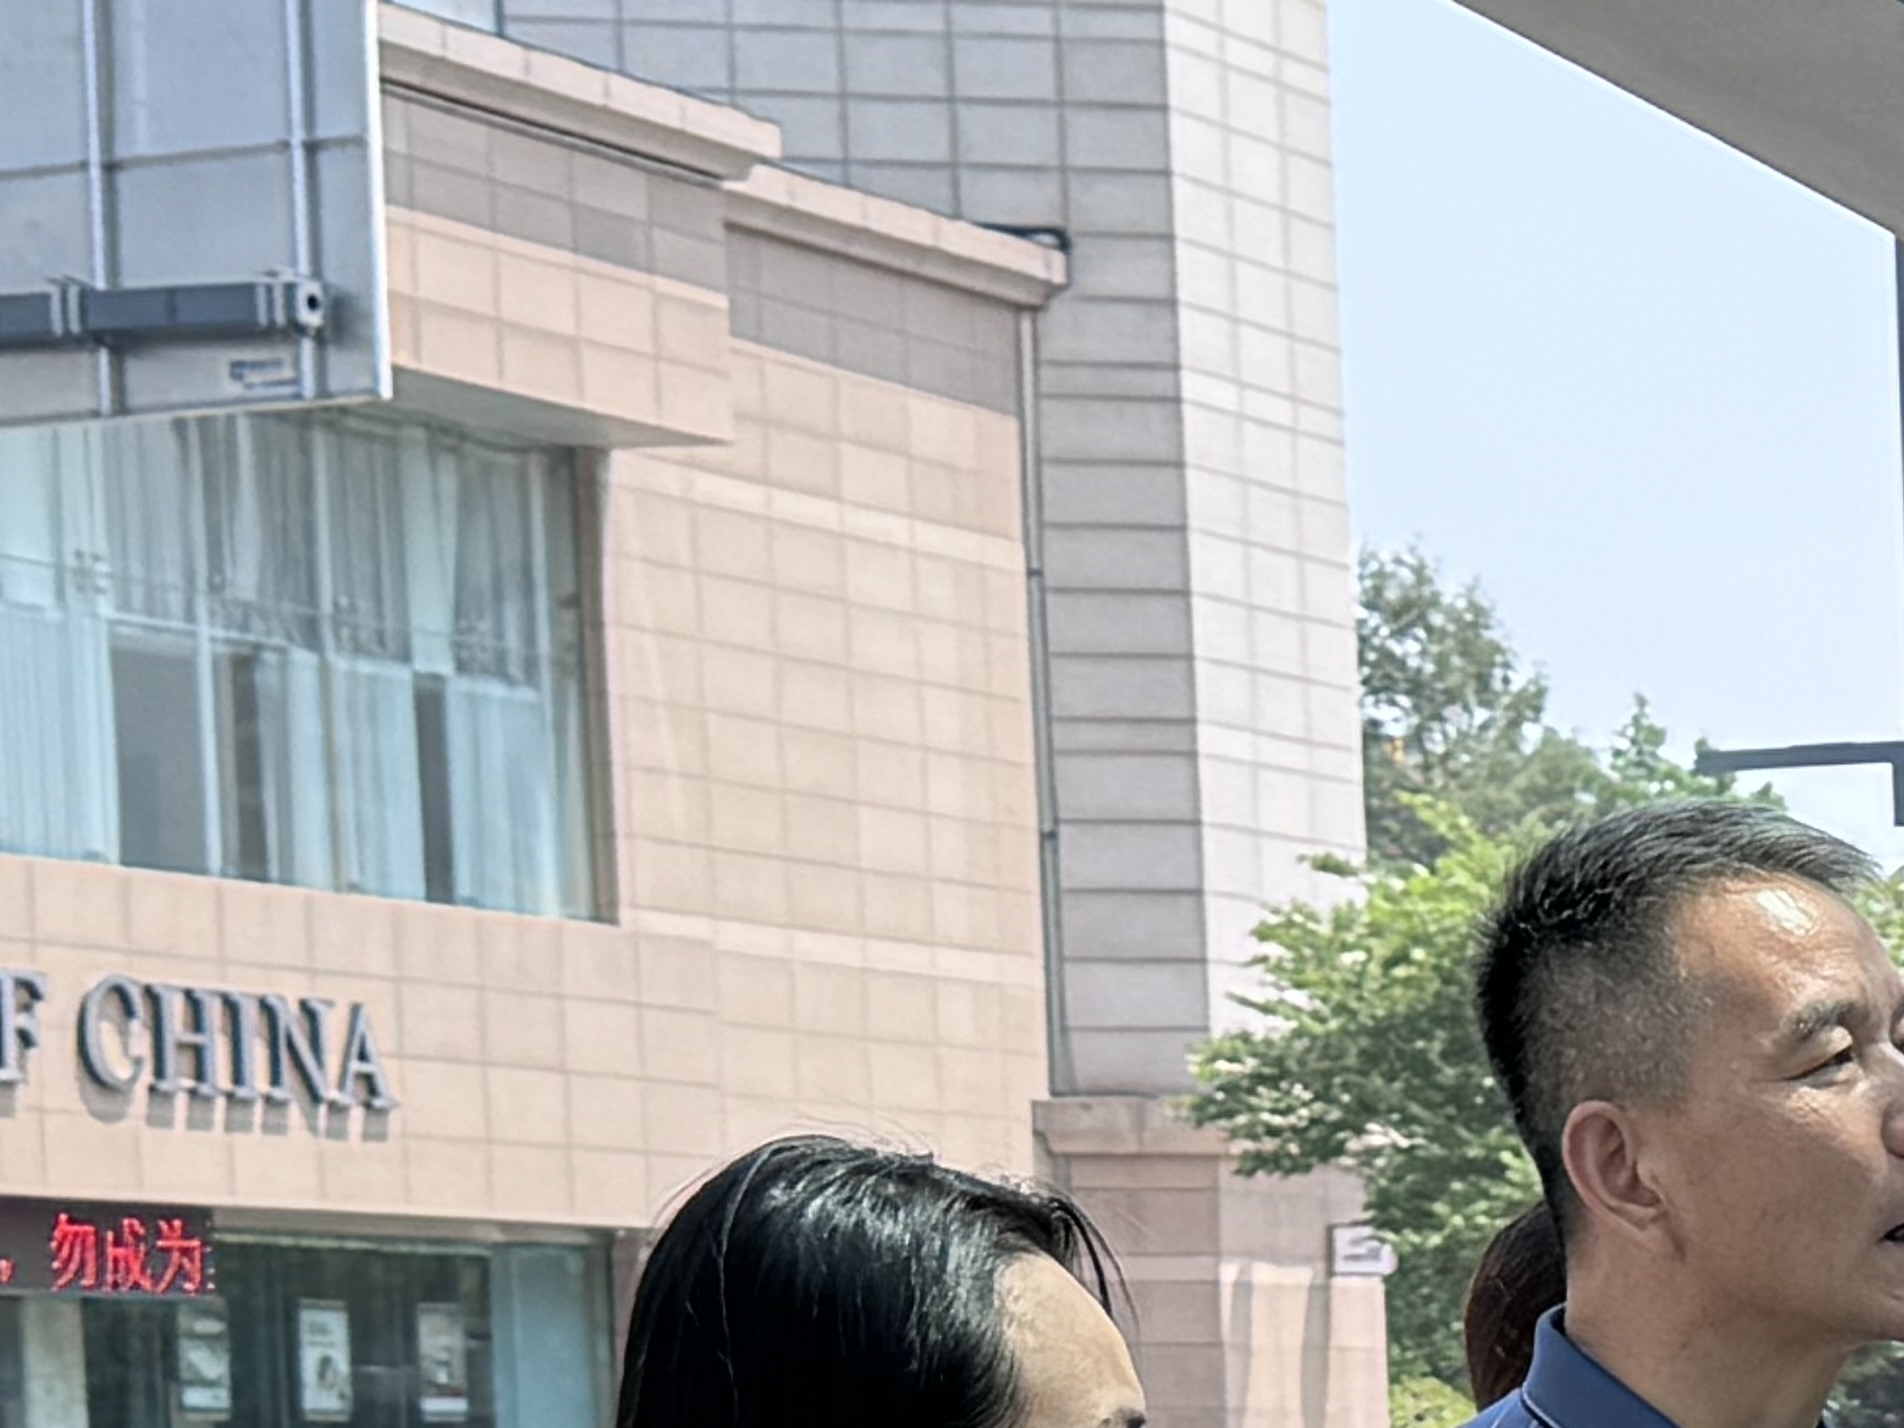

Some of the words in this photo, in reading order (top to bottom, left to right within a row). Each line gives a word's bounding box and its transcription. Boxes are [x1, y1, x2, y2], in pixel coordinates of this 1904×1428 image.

[77, 975, 399, 1111] CHINA
[50, 1213, 205, 1294] 勿成为
